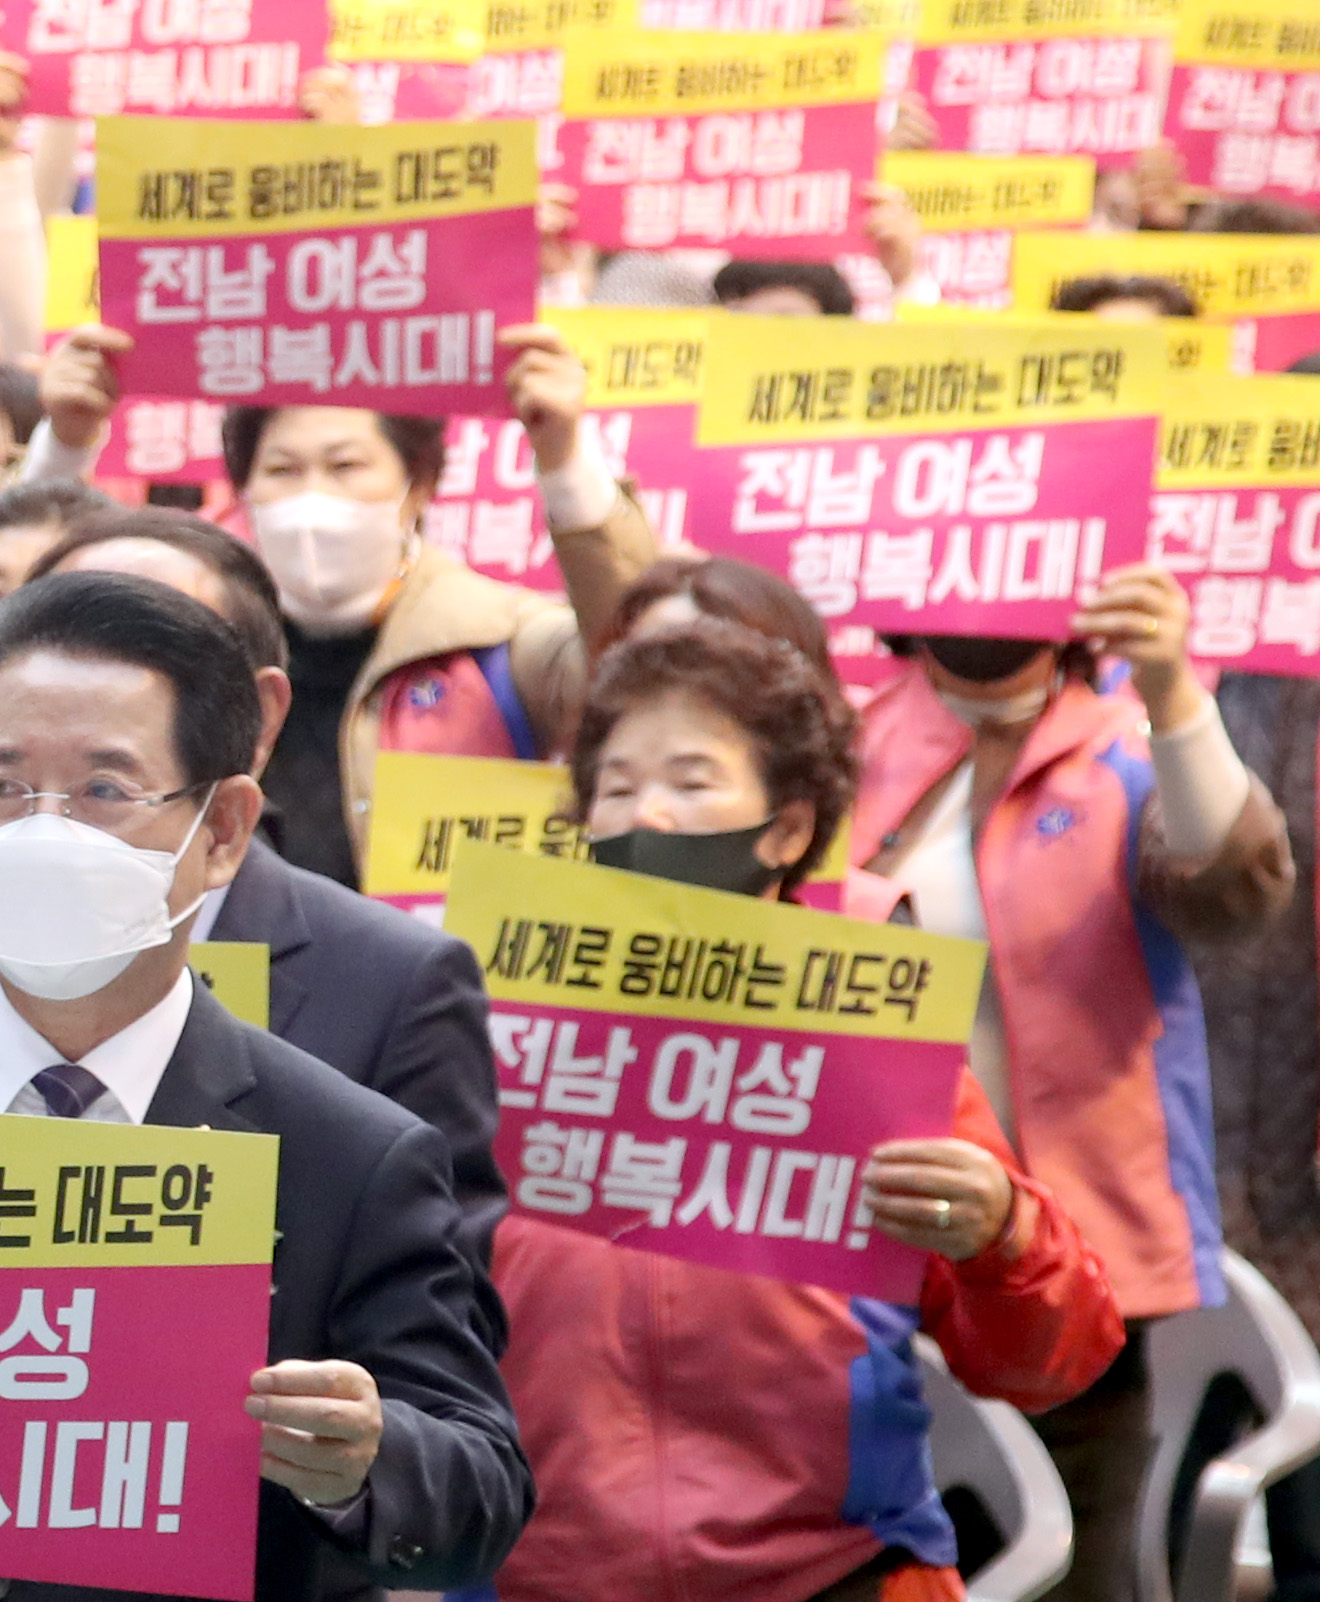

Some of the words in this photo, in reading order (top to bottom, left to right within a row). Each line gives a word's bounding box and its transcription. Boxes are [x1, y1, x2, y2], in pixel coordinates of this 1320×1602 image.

[139, 168, 236, 223] 세계로
[248, 157, 384, 219] 웅비하는
[395, 142, 501, 204] 대도약
[135, 241, 277, 325] 전남
[286, 229, 429, 312] 여성
[195, 309, 497, 396] 행복시대!
[746, 366, 854, 426] 세계로
[865, 356, 1006, 420] 웅비하는
[1015, 348, 1125, 409] 대도약
[730, 442, 887, 536] 전남
[892, 430, 1047, 518] 여성
[788, 516, 1108, 619] 행복시대!
[1144, 491, 1287, 574] 전남
[484, 916, 614, 990] 세계로
[618, 932, 788, 1012] 웅비하는
[795, 948, 932, 1024] 대도약
[488, 1012, 638, 1119] 전남
[646, 1034, 826, 1138] 여성
[51, 1163, 214, 1246] 대도약
